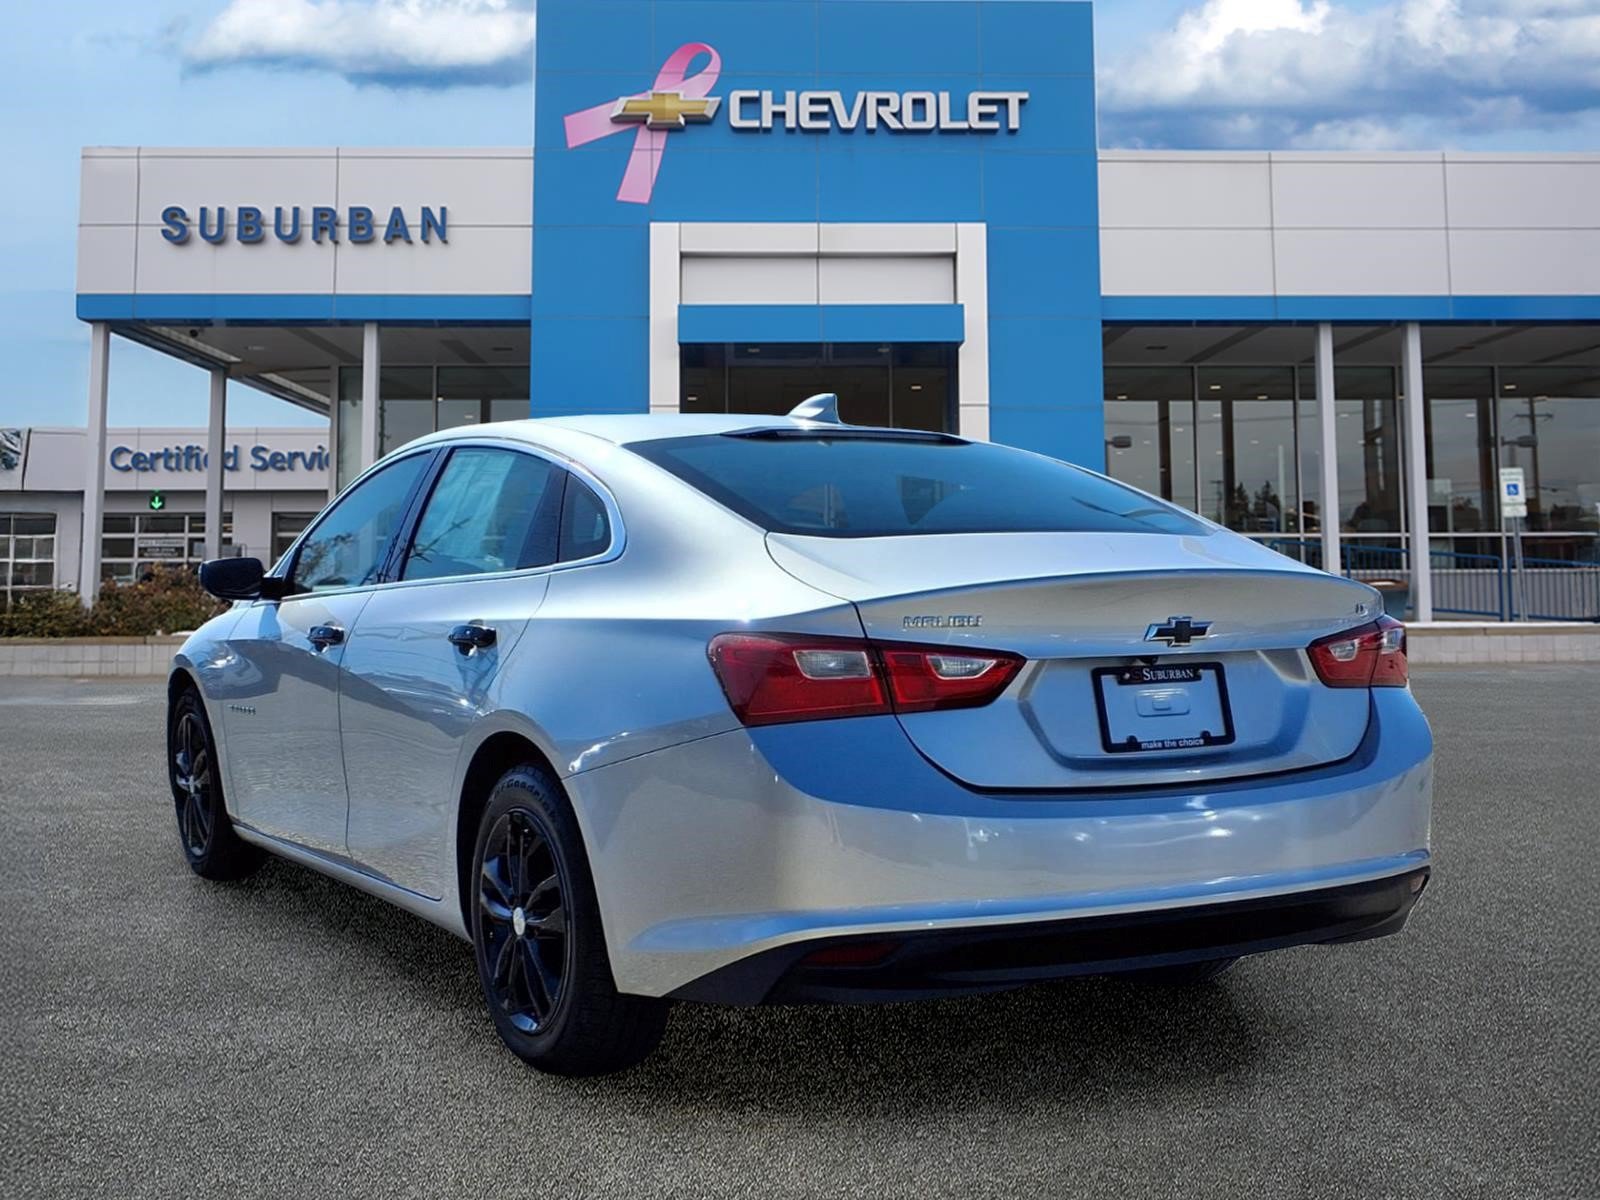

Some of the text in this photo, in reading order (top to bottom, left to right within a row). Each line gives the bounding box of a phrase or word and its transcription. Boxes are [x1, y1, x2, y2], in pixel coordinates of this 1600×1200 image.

[729, 90, 1029, 130] CHEVROLET
[161, 206, 448, 244] SUBURBAN
[110, 445, 240, 471] Certifid
[1141, 737, 1205, 750] make the choice
